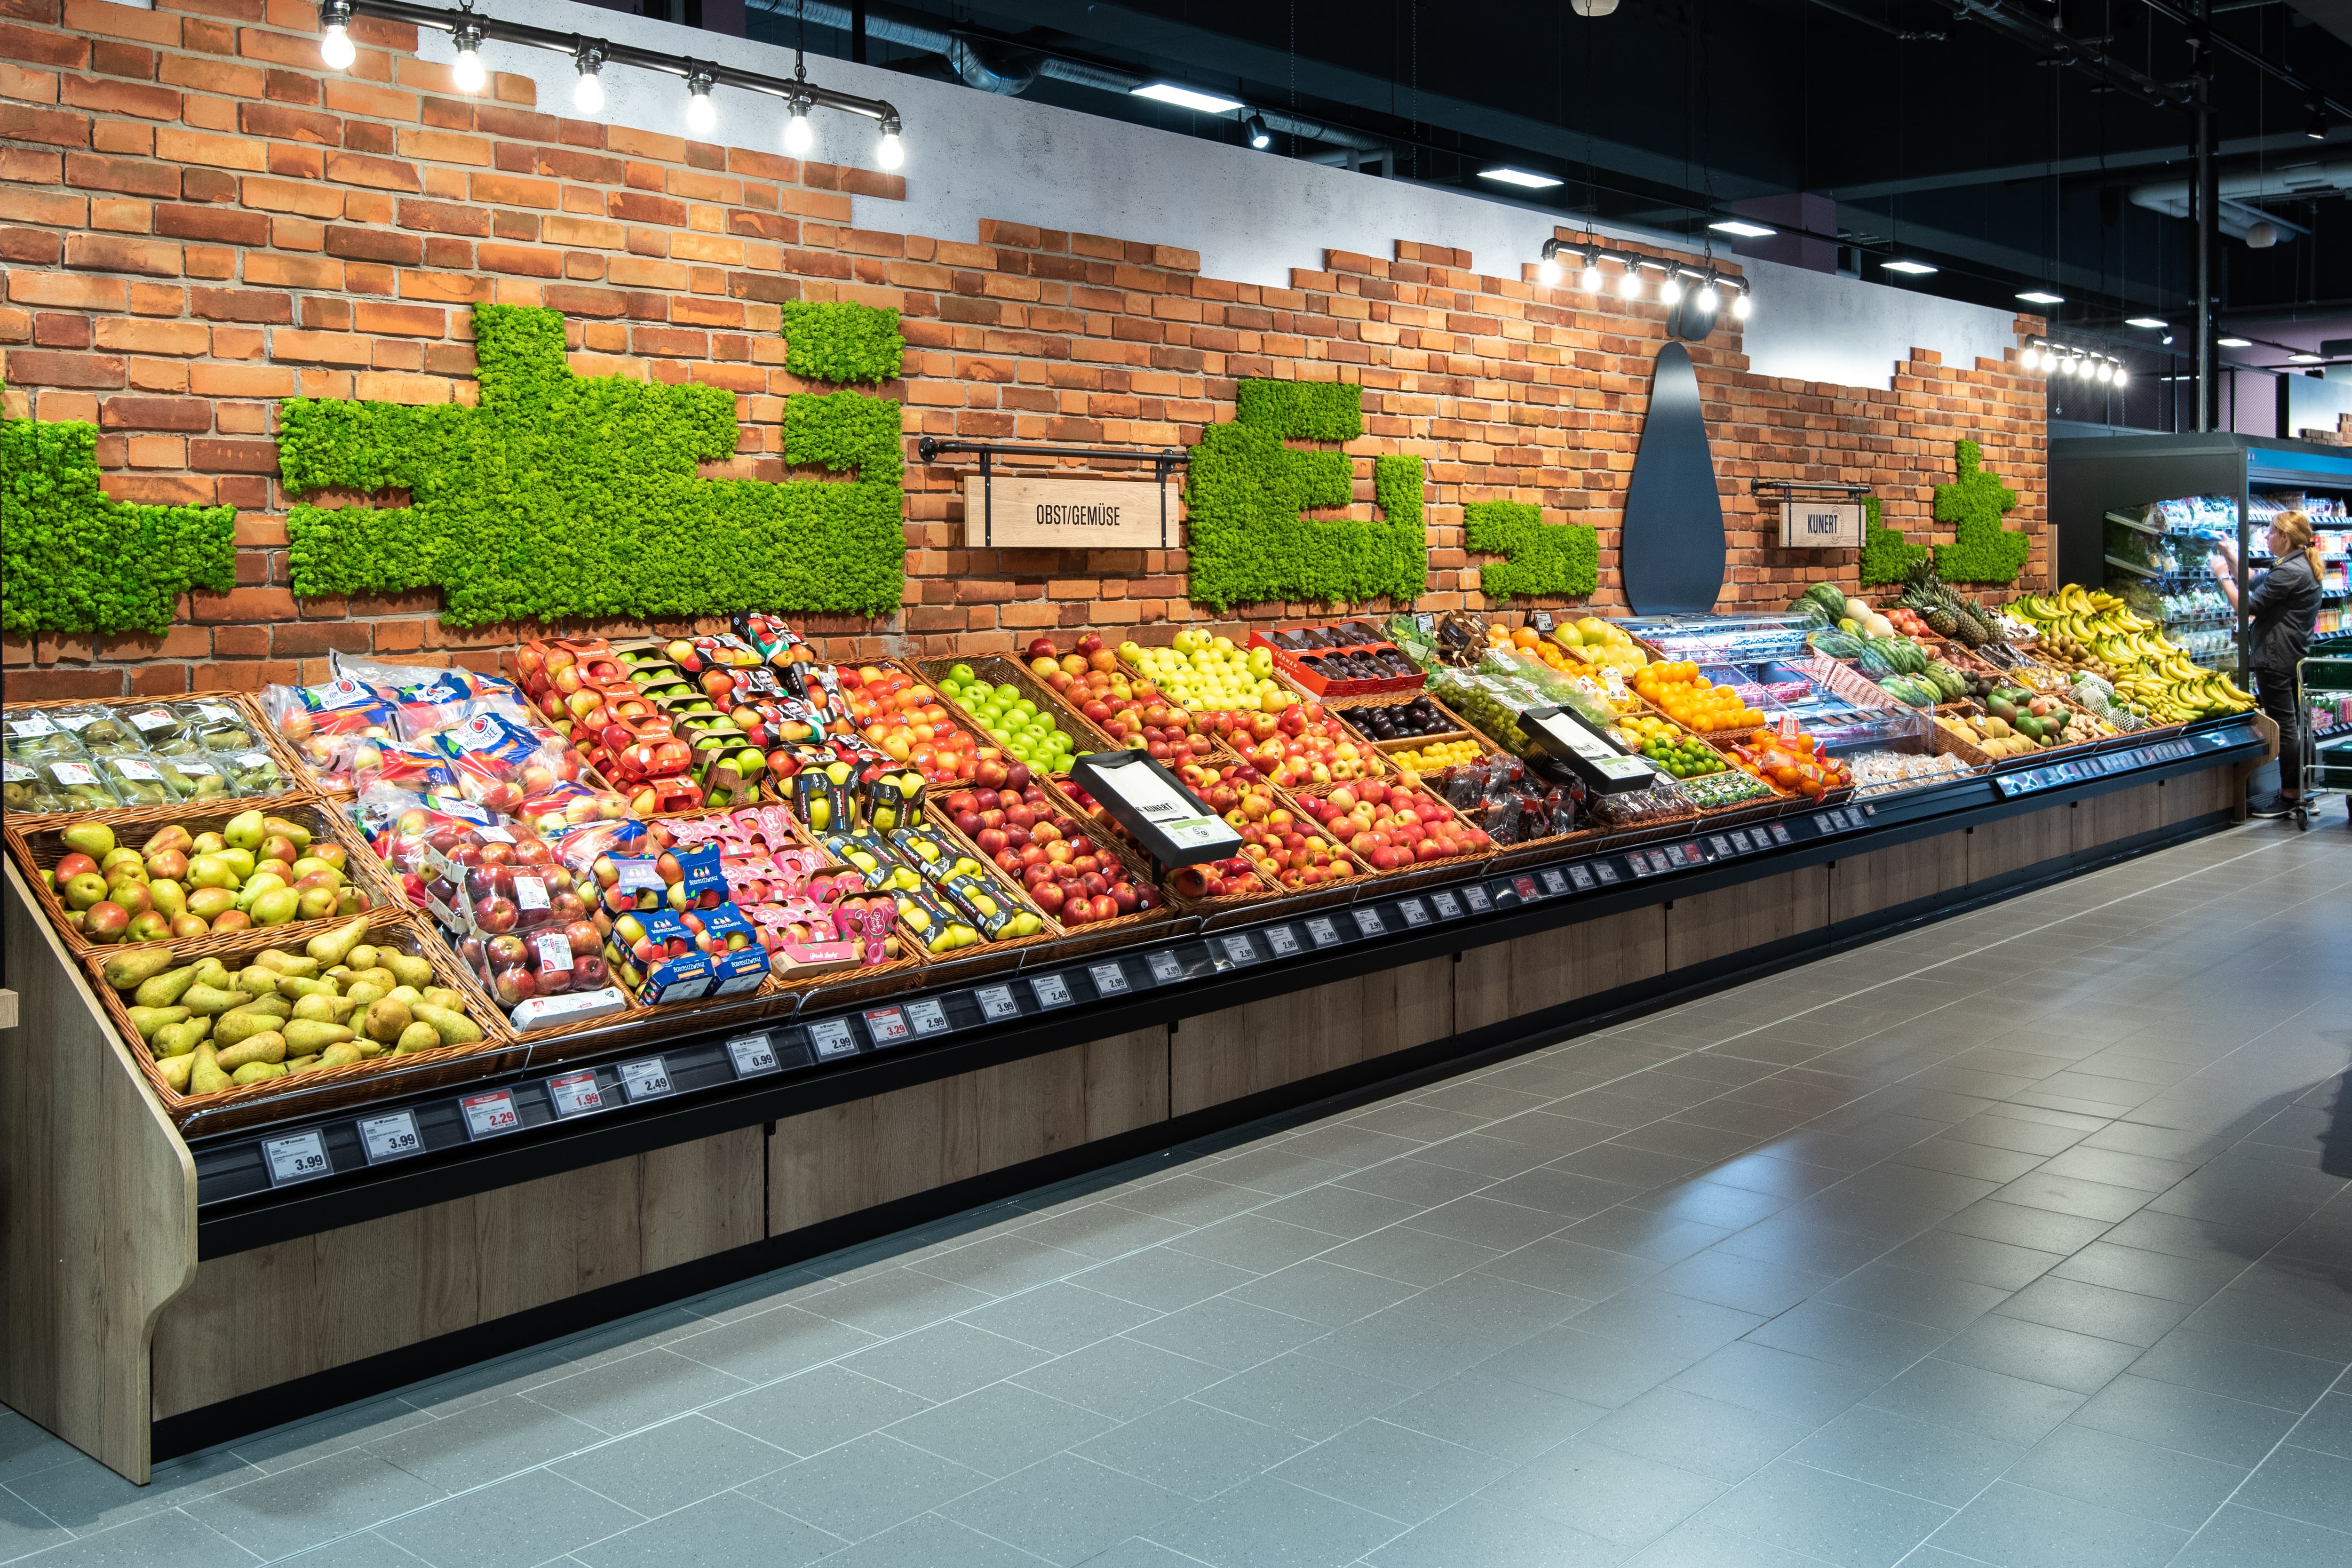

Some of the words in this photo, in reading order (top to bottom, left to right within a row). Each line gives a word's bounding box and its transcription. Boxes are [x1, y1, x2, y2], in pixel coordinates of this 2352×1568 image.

[1036, 503, 1120, 526] OBST/GEMÜSE
[1807, 514, 1838, 534] KUNERT
[1451, 638, 1461, 650] lese
[1274, 651, 1298, 669] ZÖRNER
[325, 691, 364, 707] BODENSEE
[464, 727, 498, 747] BODENSEE
[445, 808, 484, 818] BODENSEE
[1141, 803, 1173, 812] KUNERT
[903, 845, 920, 862] bergäpfel
[1526, 888, 1537, 897] 5.90
[958, 895, 977, 914] bergäpfel
[1446, 905, 1459, 913] 2.99
[1414, 912, 1426, 920] 3.99
[870, 915, 878, 933] Lady
[1369, 921, 1382, 931] 2.99
[1323, 931, 1336, 940] 2.99
[1282, 939, 1296, 949] 2.99
[1240, 948, 1253, 958] 2.99
[1165, 965, 1180, 976] 3.99
[1109, 978, 1125, 988] 2.99
[1051, 990, 1068, 1001] 2.49
[997, 1001, 1014, 1013] 3.99
[927, 1016, 945, 1028] 2.99
[887, 1024, 906, 1036] 3.29
[832, 1037, 851, 1049] 2.99
[752, 1054, 773, 1067] 0.99
[644, 1077, 667, 1091] 2.49
[576, 1092, 599, 1106] 1.99
[489, 1111, 515, 1126] 2.29
[389, 1133, 416, 1149] 3.99
[294, 1154, 324, 1171] 3.99
